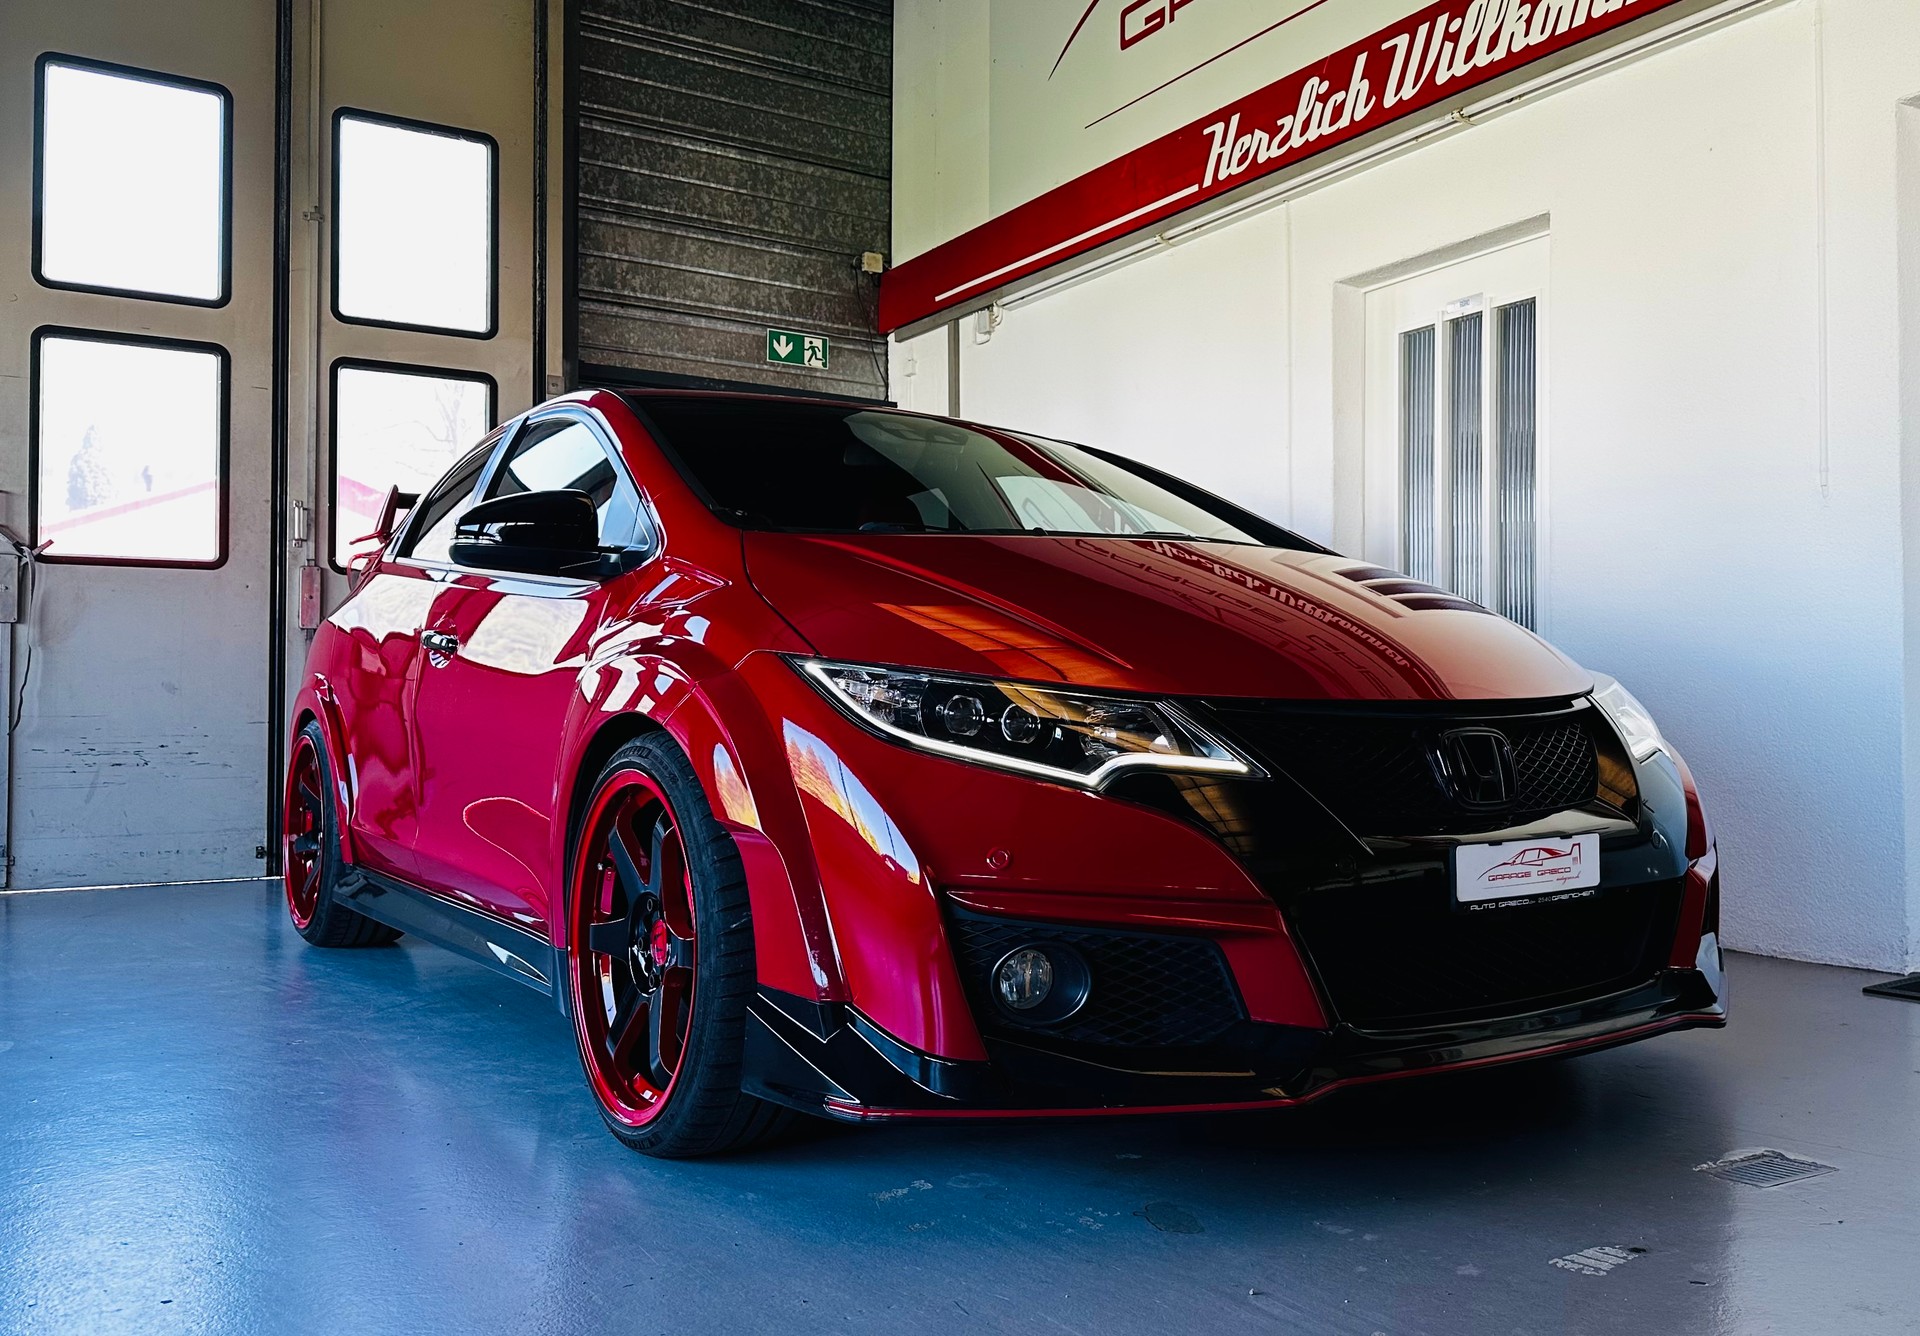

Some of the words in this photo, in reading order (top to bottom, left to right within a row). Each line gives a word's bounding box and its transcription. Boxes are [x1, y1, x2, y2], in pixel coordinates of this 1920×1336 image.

[1203, 52, 1376, 188] Herzlich
[1488, 870, 1532, 882] GARAGE
[1537, 866, 1571, 877] GRECO
[1470, 902, 1496, 911] AUTO
[1498, 898, 1530, 908] GRECO
[1551, 889, 1595, 901] GRENCHEN
